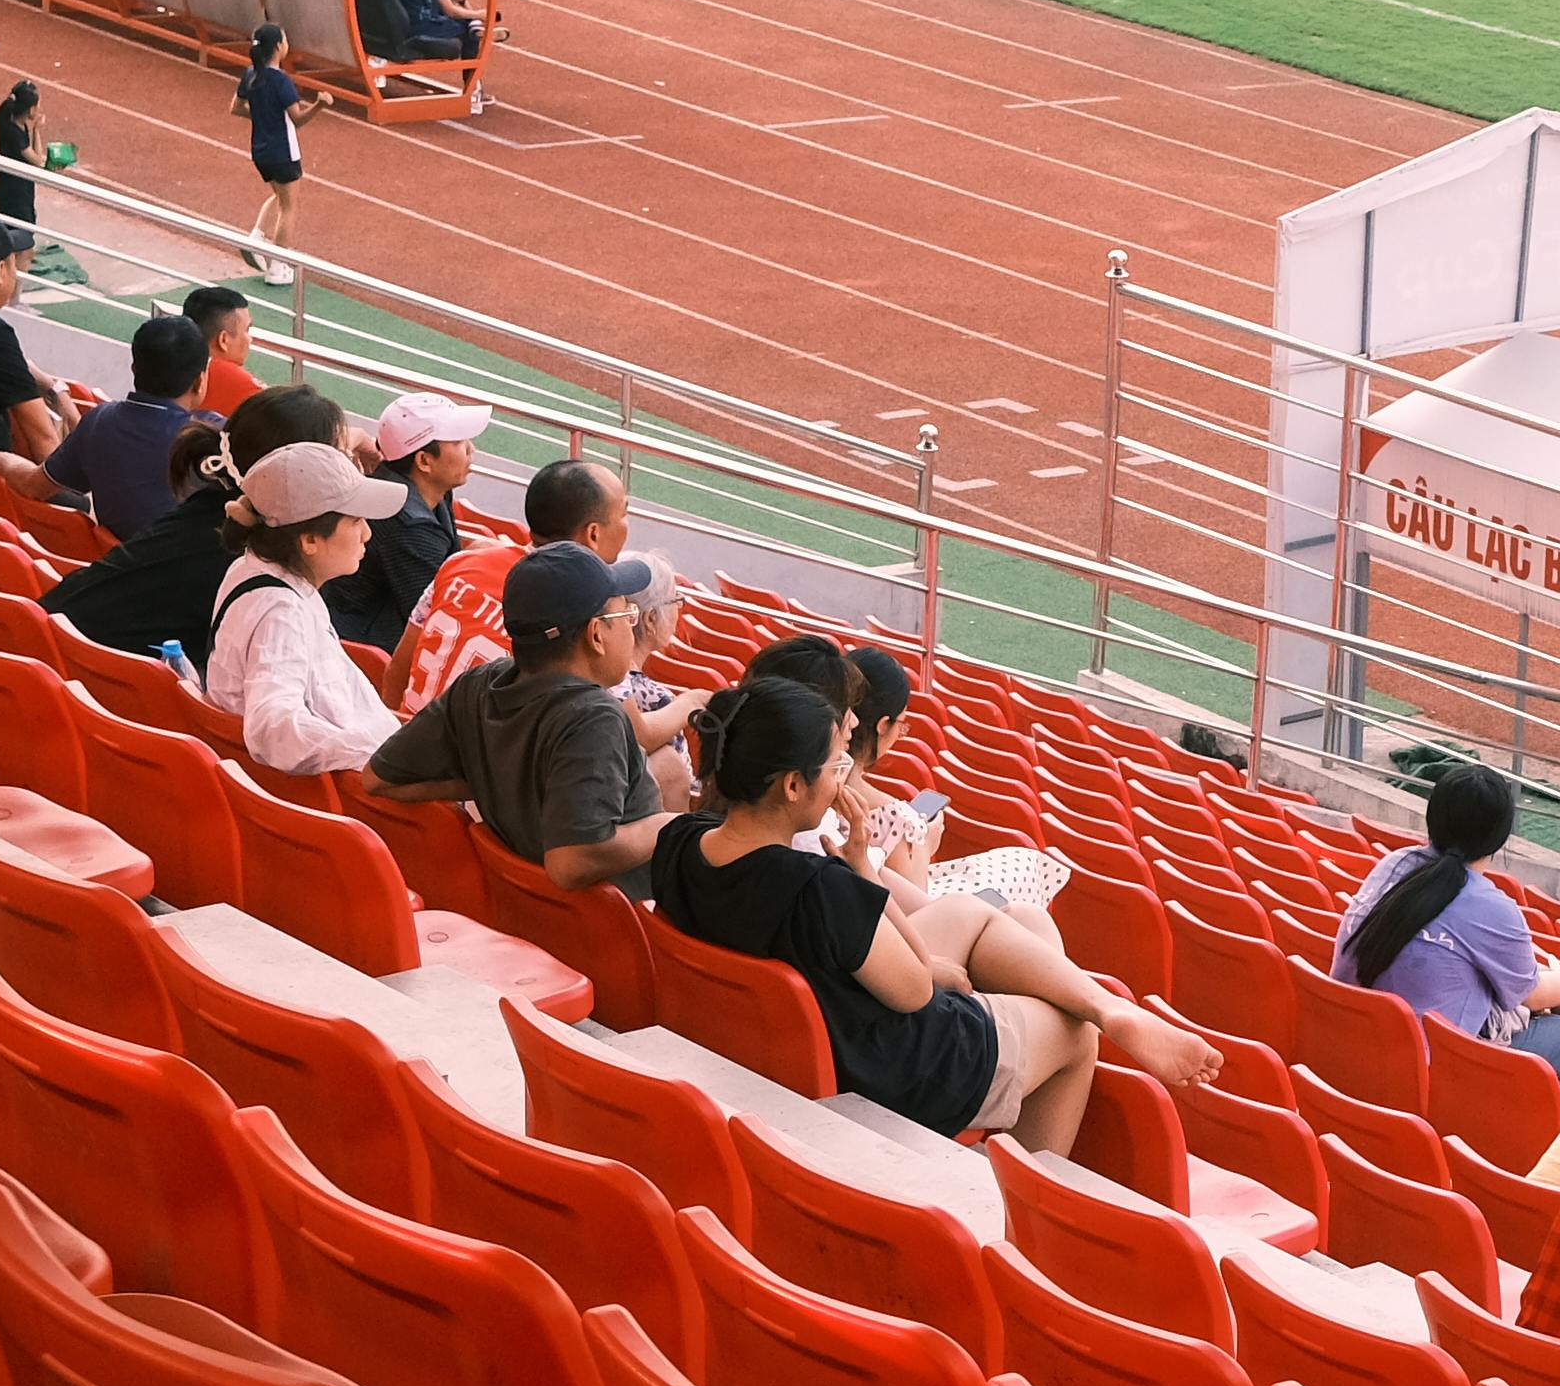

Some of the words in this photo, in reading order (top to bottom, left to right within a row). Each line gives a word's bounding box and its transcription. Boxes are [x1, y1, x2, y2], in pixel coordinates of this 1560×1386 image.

[1385, 475, 1454, 551] CÂU
[1465, 503, 1532, 583] LẠC
[443, 576, 477, 609] FC
